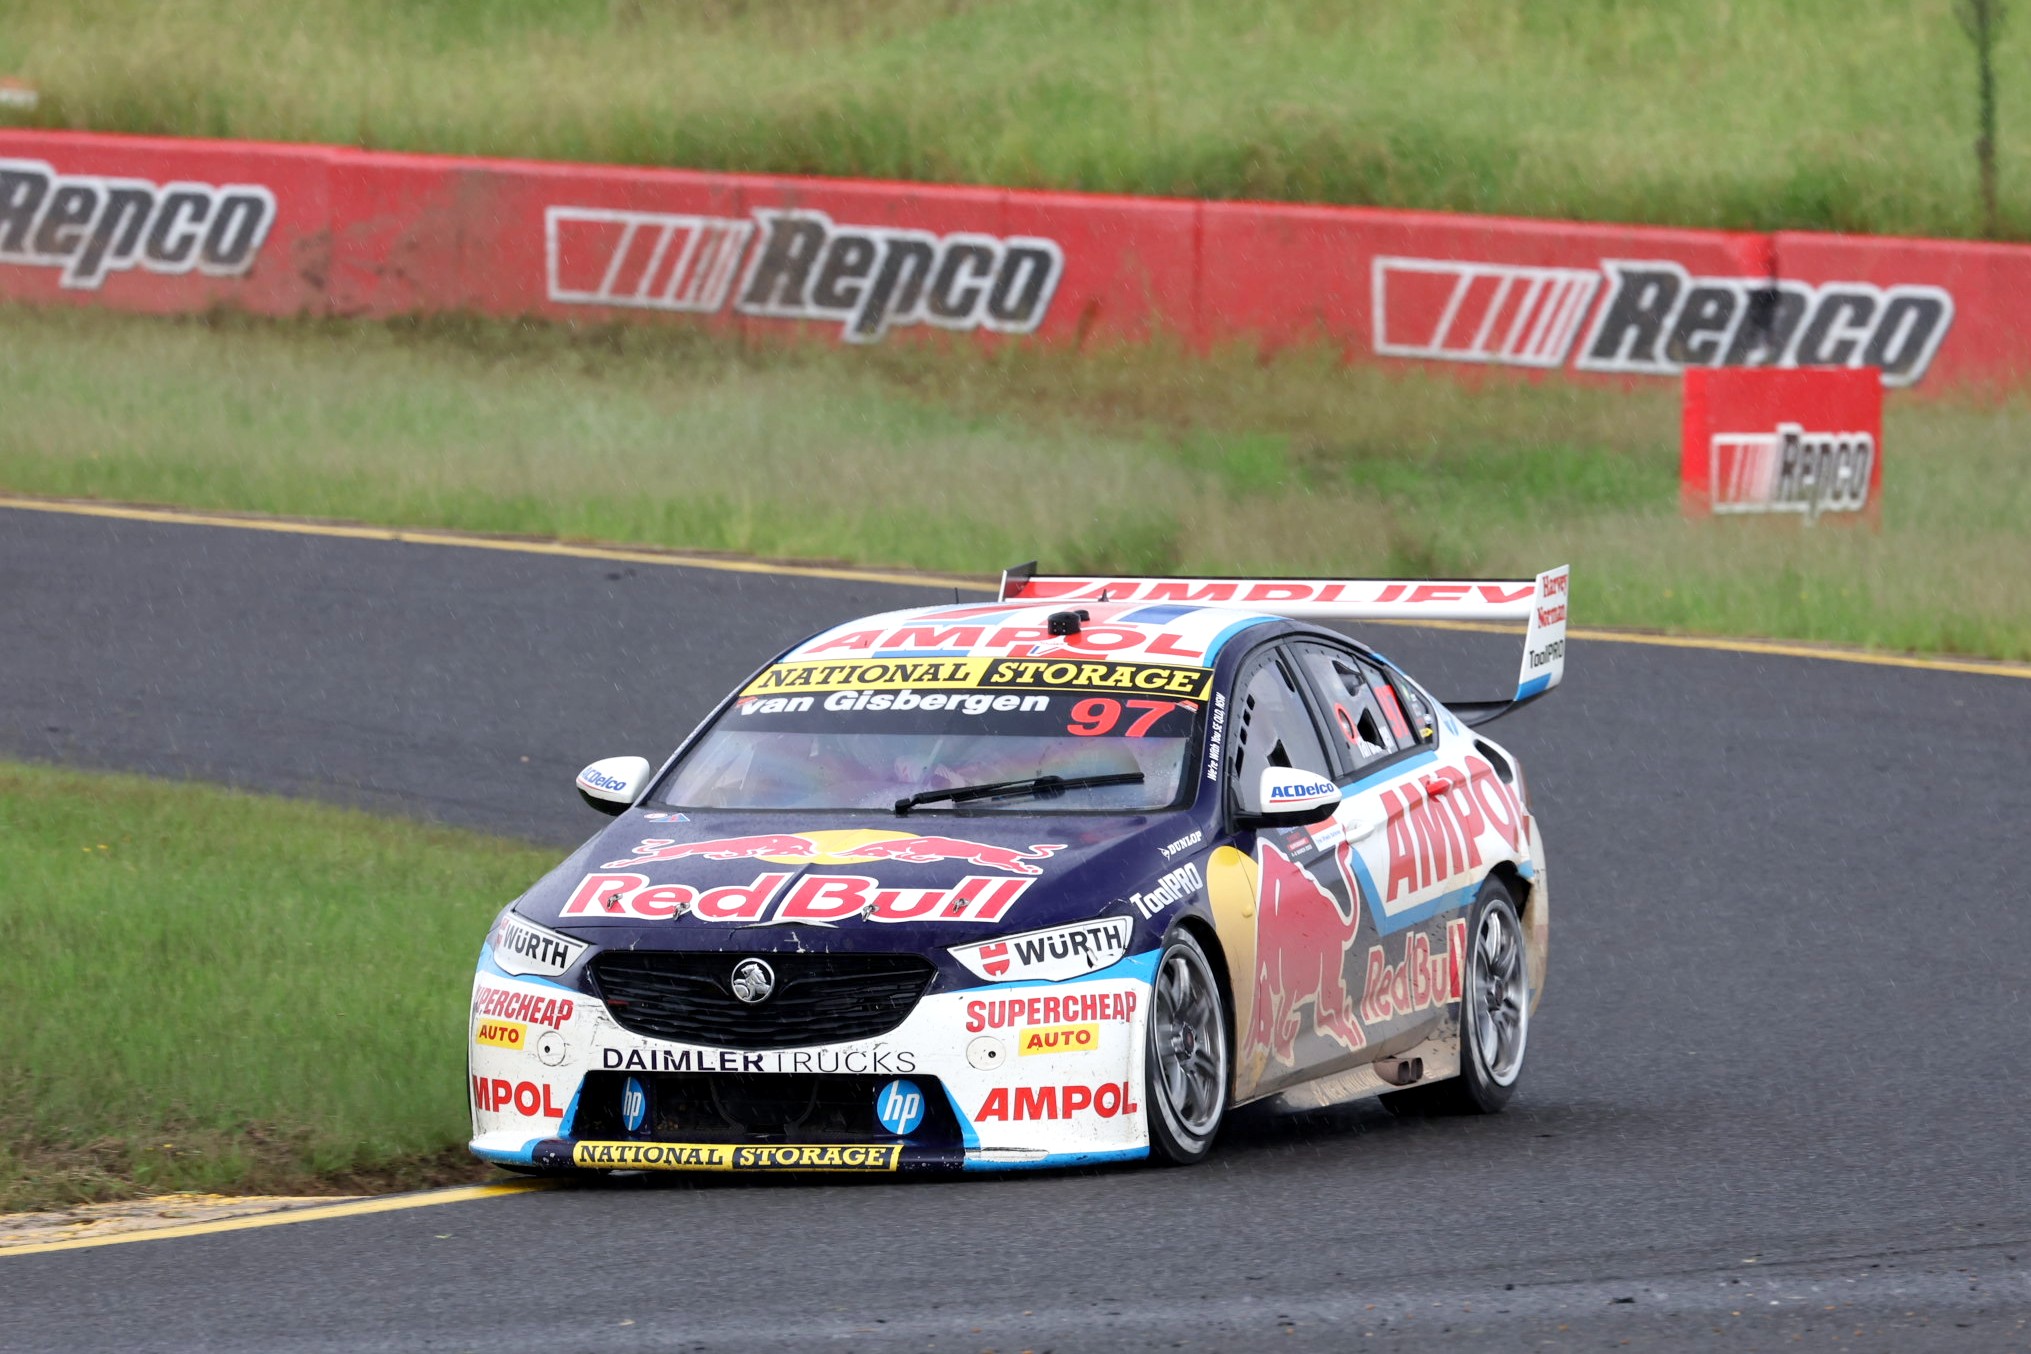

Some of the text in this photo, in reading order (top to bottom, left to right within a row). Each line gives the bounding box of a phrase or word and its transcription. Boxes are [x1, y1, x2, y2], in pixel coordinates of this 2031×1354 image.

[0, 158, 276, 288] Repco
[735, 207, 1063, 343] Repco
[1574, 258, 1954, 387] Repco
[1777, 422, 1874, 520] Repco
[1542, 574, 1568, 598] Harvey
[1537, 604, 1566, 629] Norman
[802, 623, 1205, 658] AMPOL
[1530, 639, 1565, 669] ToolPRO
[760, 661, 1201, 693] NATIONAL STORAGE
[741, 690, 1050, 716] van Gisbergen
[1067, 698, 1177, 738] 97
[1209, 741, 1220, 762] With
[1210, 731, 1222, 745] You
[1271, 782, 1335, 798] ACDelco
[1167, 831, 1202, 856] DUNLOP
[560, 872, 1038, 923] Red Bull
[1130, 861, 1204, 920] ToolPRO
[503, 922, 569, 970] WÜRTH
[1013, 925, 1122, 966] WÜRTH
[966, 991, 1137, 1033] SUPERCHEAP
[479, 1024, 520, 1043] AUTO
[1026, 1029, 1091, 1050] AUTO
[602, 1048, 917, 1073] DAIMLER TRUCKS
[472, 1074, 564, 1118] MPOL
[623, 1077, 641, 1131] hp
[883, 1080, 922, 1134] hp
[974, 1081, 1138, 1122] AMPOL
[579, 1144, 886, 1168] NATIONAL STORAGE
